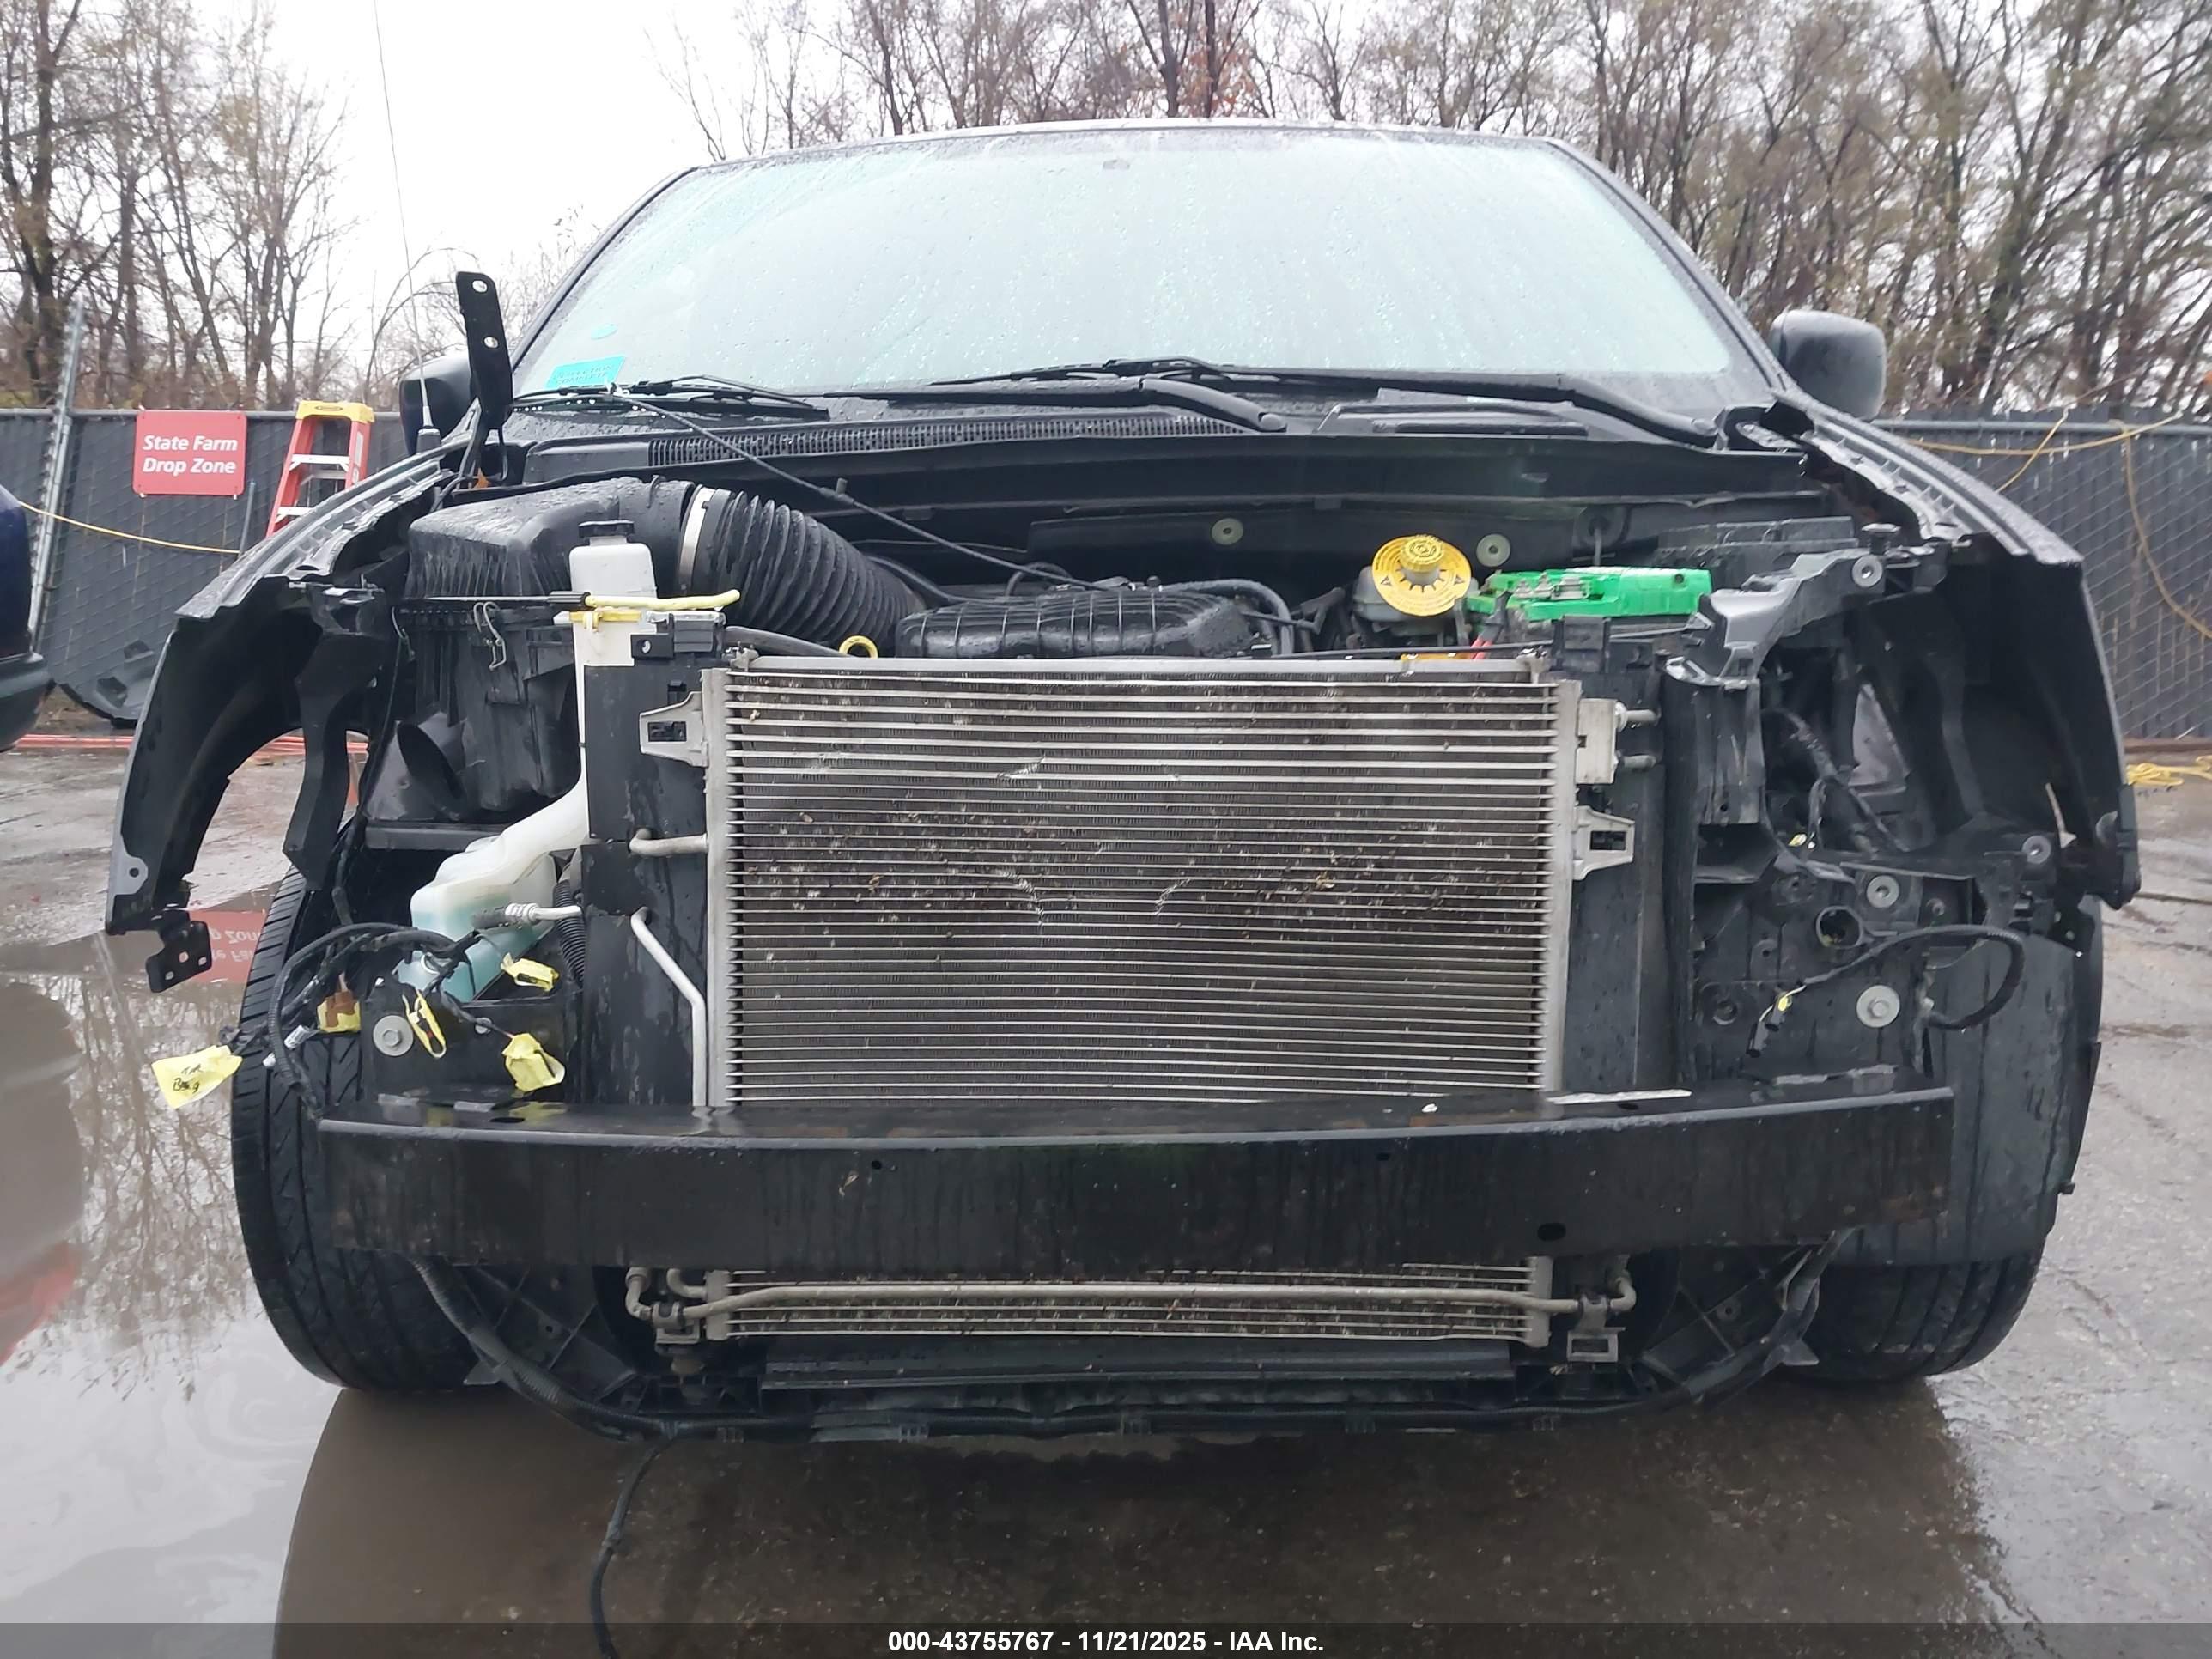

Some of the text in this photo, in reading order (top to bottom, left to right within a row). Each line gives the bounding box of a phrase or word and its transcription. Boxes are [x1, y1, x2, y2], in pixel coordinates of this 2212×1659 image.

[142, 434, 238, 451] State Farm
[142, 458, 236, 477] Drop Zone
